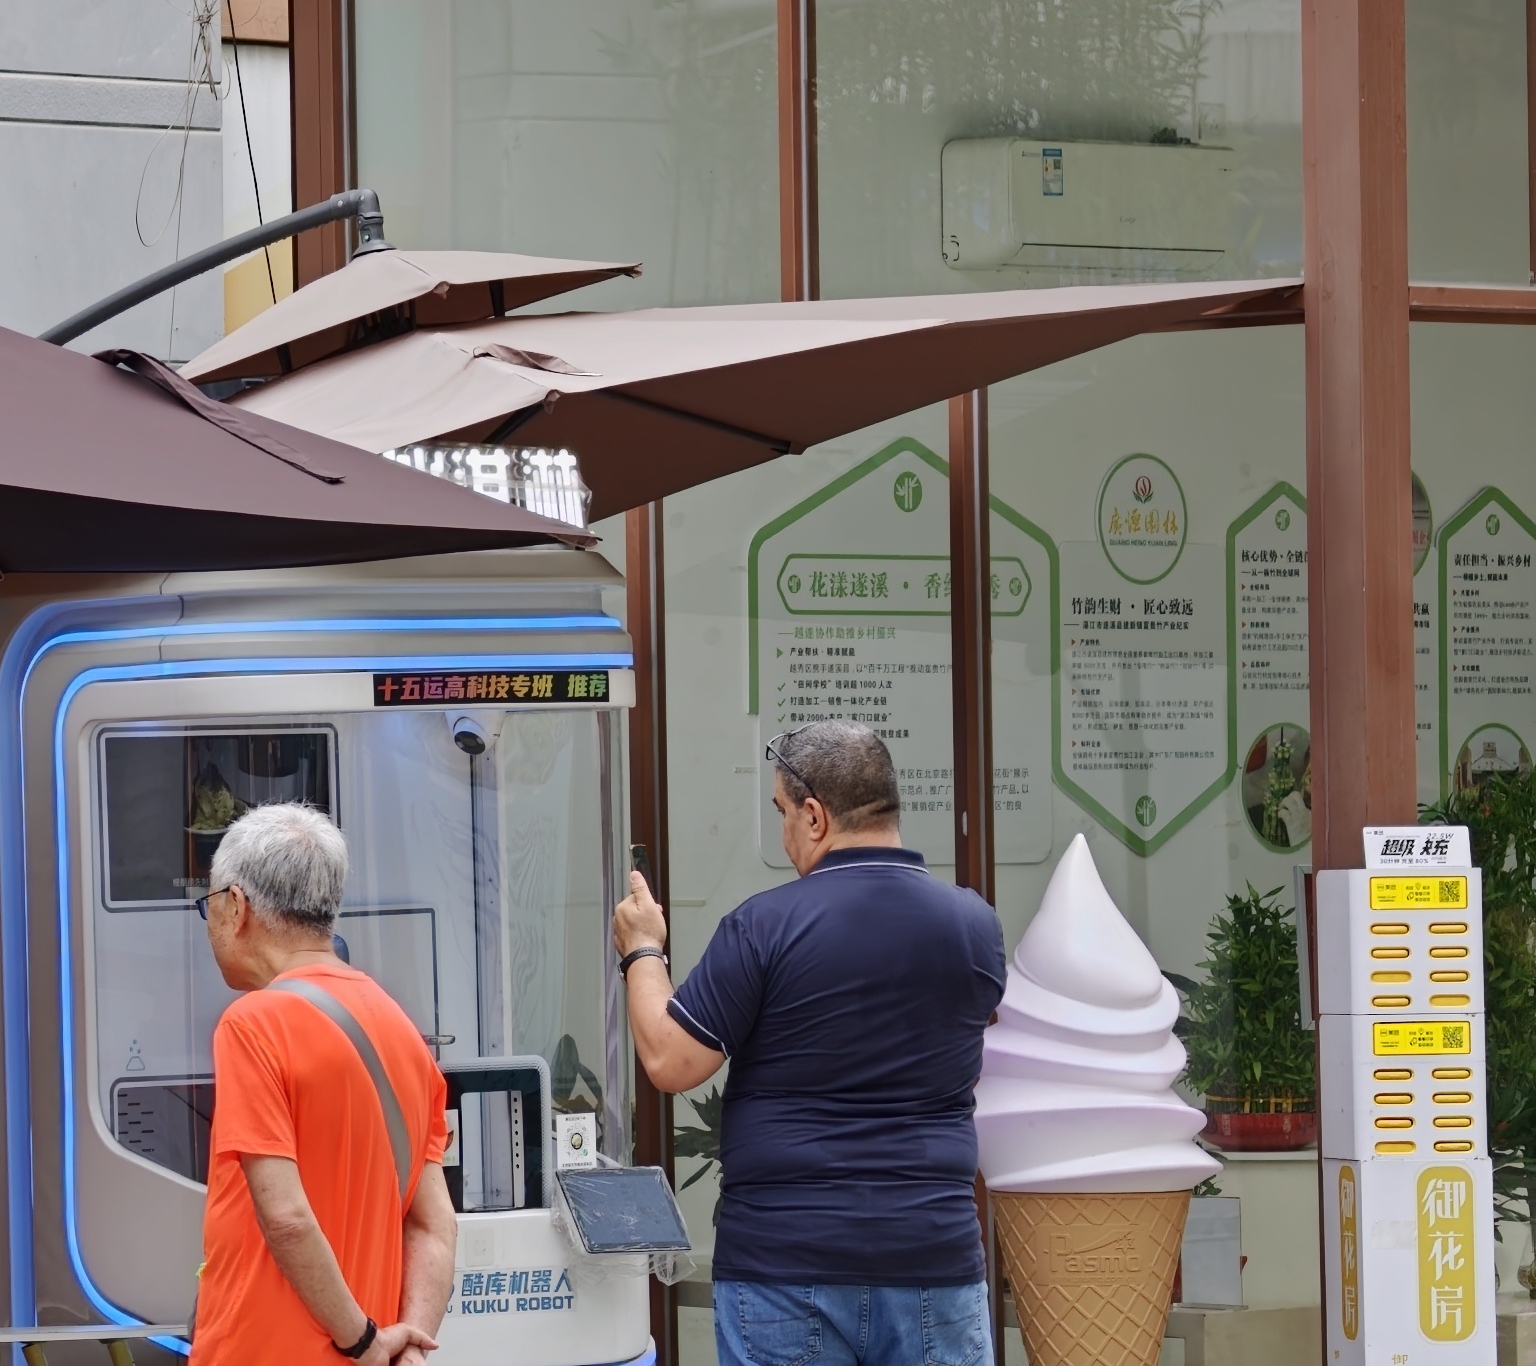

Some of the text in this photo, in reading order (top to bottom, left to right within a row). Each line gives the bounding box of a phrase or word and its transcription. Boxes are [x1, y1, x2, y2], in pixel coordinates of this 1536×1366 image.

[382, 446, 584, 529] 淇淋
[808, 571, 889, 599] 花漾遂溪
[1071, 597, 1194, 616] 竹韵生财 匠心致远
[377, 673, 608, 702] 十五运高科技专班 推荐
[1380, 838, 1415, 857] 超级
[1421, 1178, 1466, 1335] 御花房
[461, 1268, 573, 1297] 酷库机器人
[461, 1298, 510, 1315] KUKU
[516, 1296, 575, 1312] ROBOT
